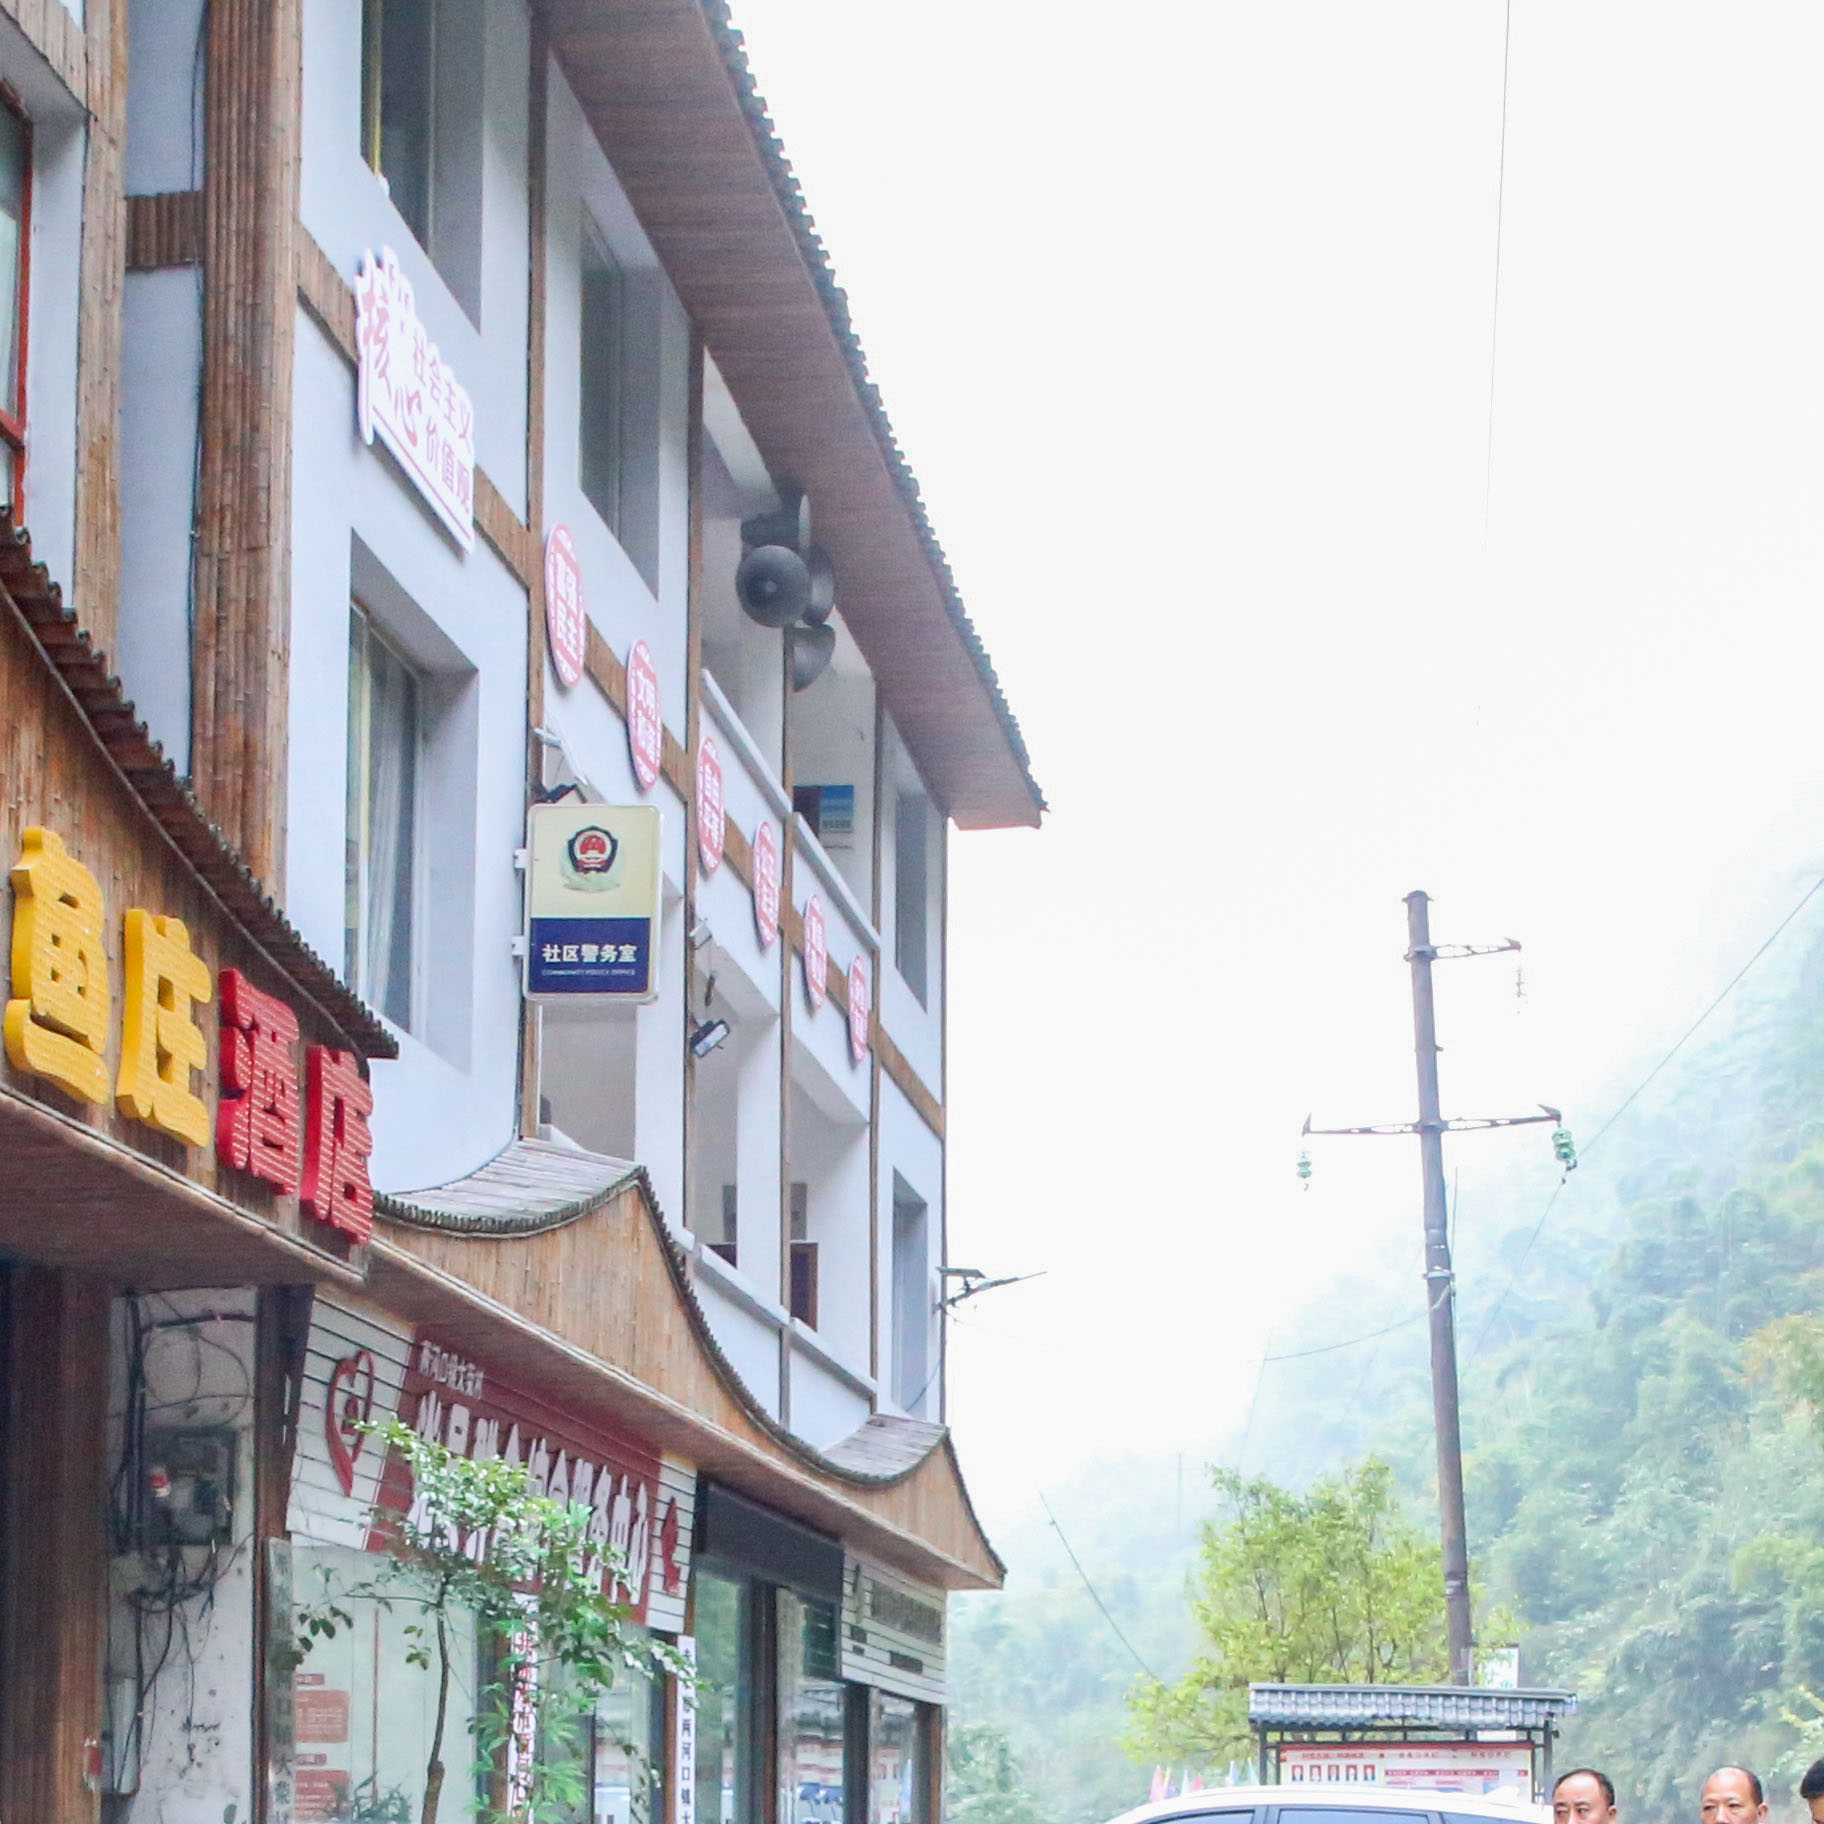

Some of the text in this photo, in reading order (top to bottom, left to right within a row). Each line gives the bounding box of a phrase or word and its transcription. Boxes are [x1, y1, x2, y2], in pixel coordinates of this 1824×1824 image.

[541, 943, 638, 964] 社区警务室
